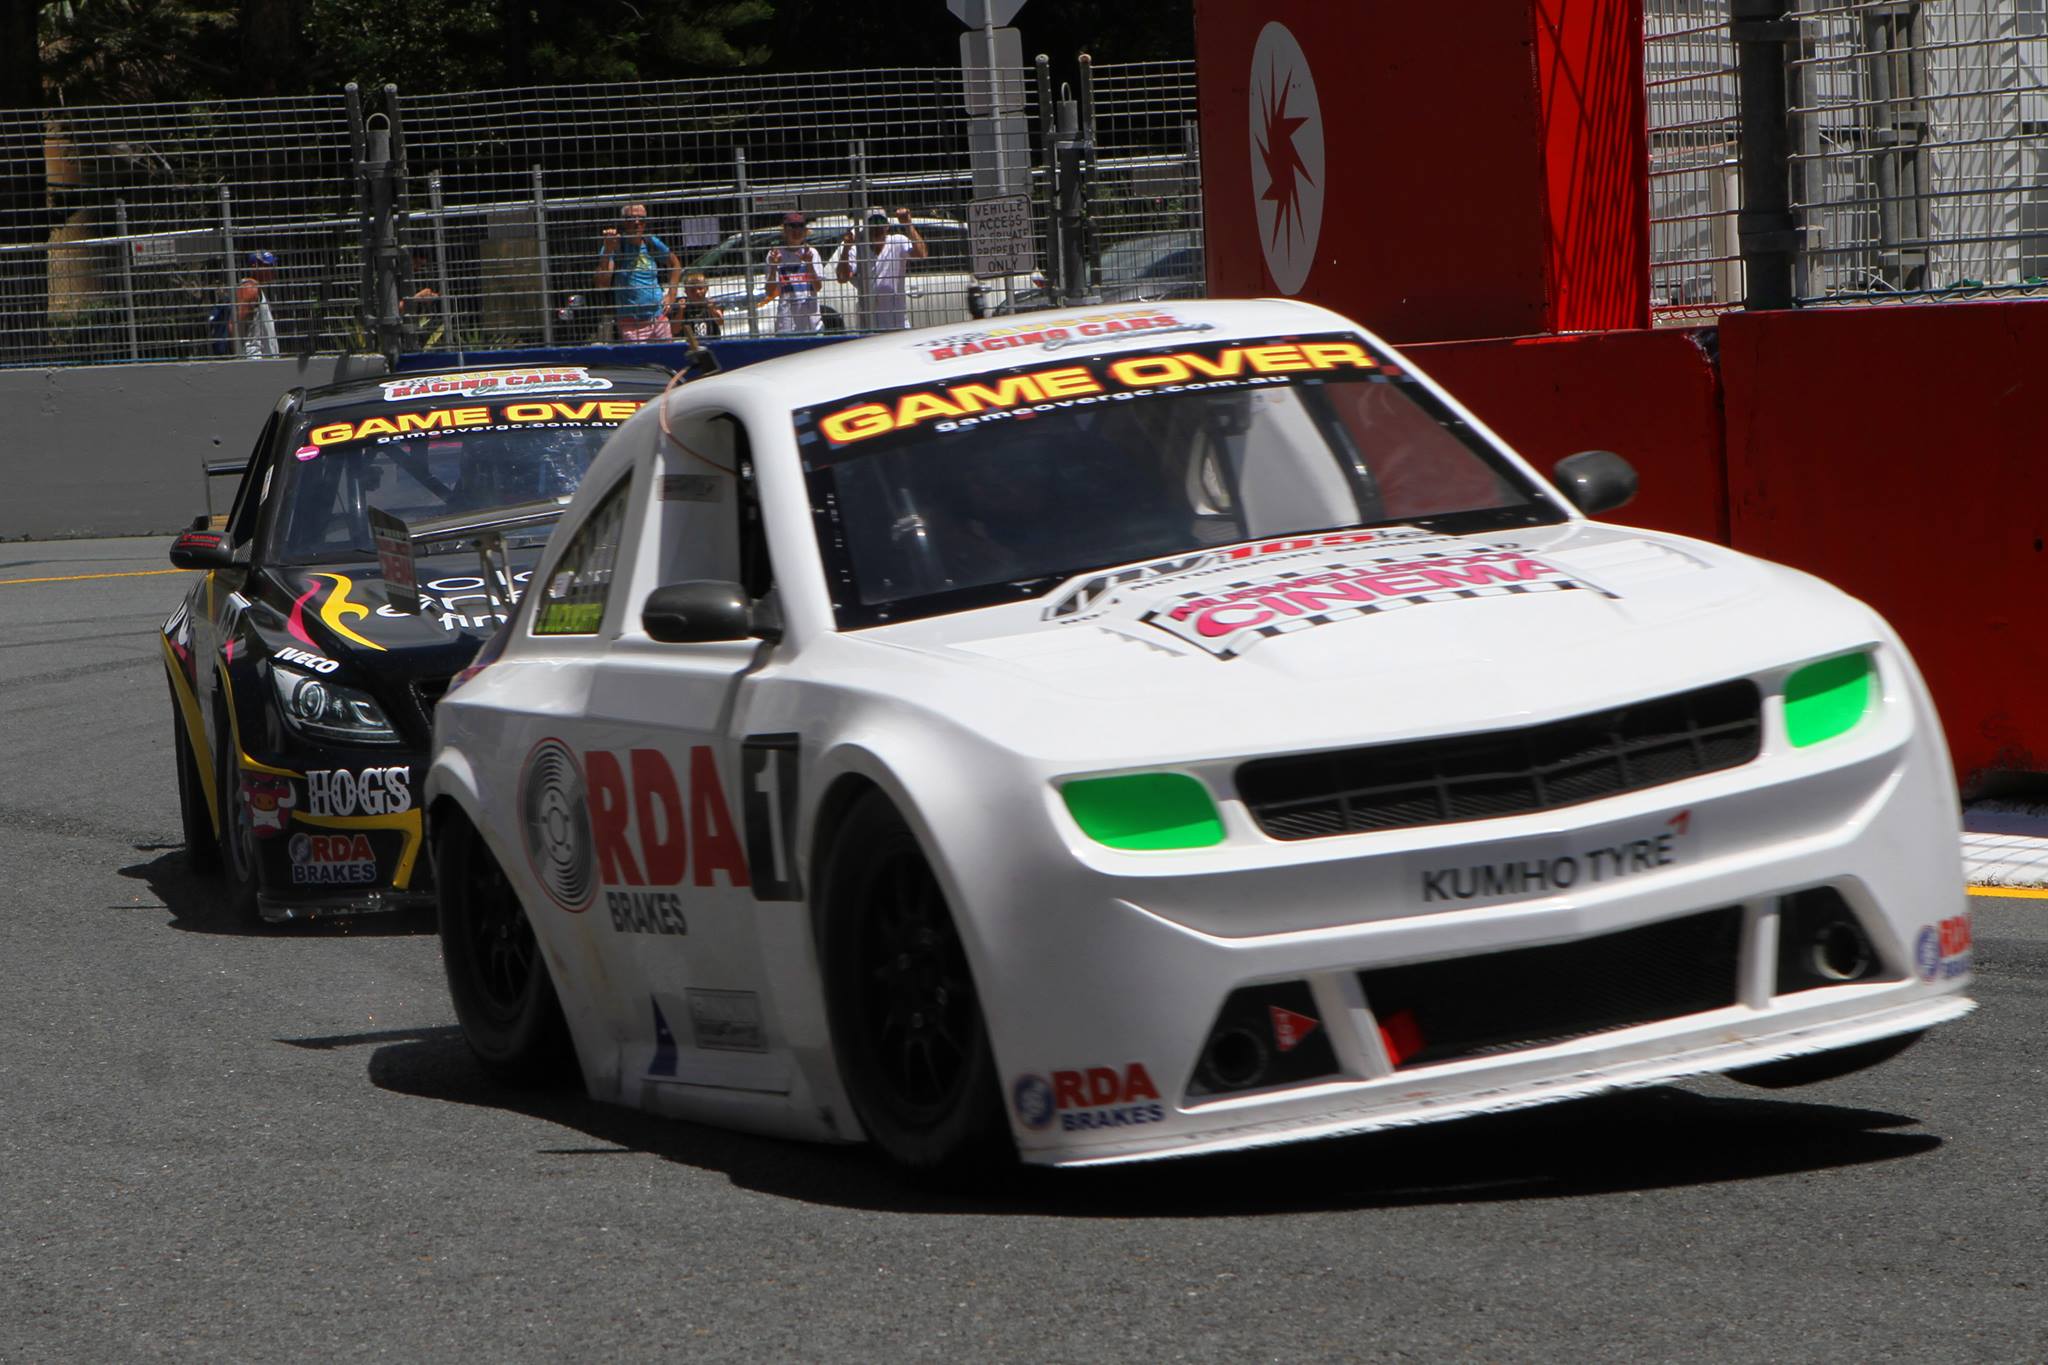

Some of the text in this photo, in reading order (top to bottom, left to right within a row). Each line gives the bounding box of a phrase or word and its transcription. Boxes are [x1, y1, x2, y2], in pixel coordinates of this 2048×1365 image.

[974, 200, 1024, 216] VEHICLE
[979, 214, 1022, 231] ACCESS
[987, 257, 1018, 272] ONLY
[929, 327, 1070, 361] RACING
[1077, 316, 1179, 336] CARS
[392, 373, 582, 398] RACING CARS
[820, 343, 1378, 444] GAME OVER
[310, 401, 645, 446] GAME OVE
[376, 420, 619, 444] gameovergc.com.au
[1195, 559, 1559, 637] CINEMA
[274, 646, 340, 674] IVECO
[584, 746, 791, 887] RDA 1
[311, 834, 375, 862] RDA
[293, 864, 376, 883] BRAKES
[1421, 833, 1675, 901] KUMHO TYRE
[606, 891, 689, 936] BRAKES
[1051, 1062, 1162, 1109] RDA
[1060, 1103, 1166, 1132] BRAKES
